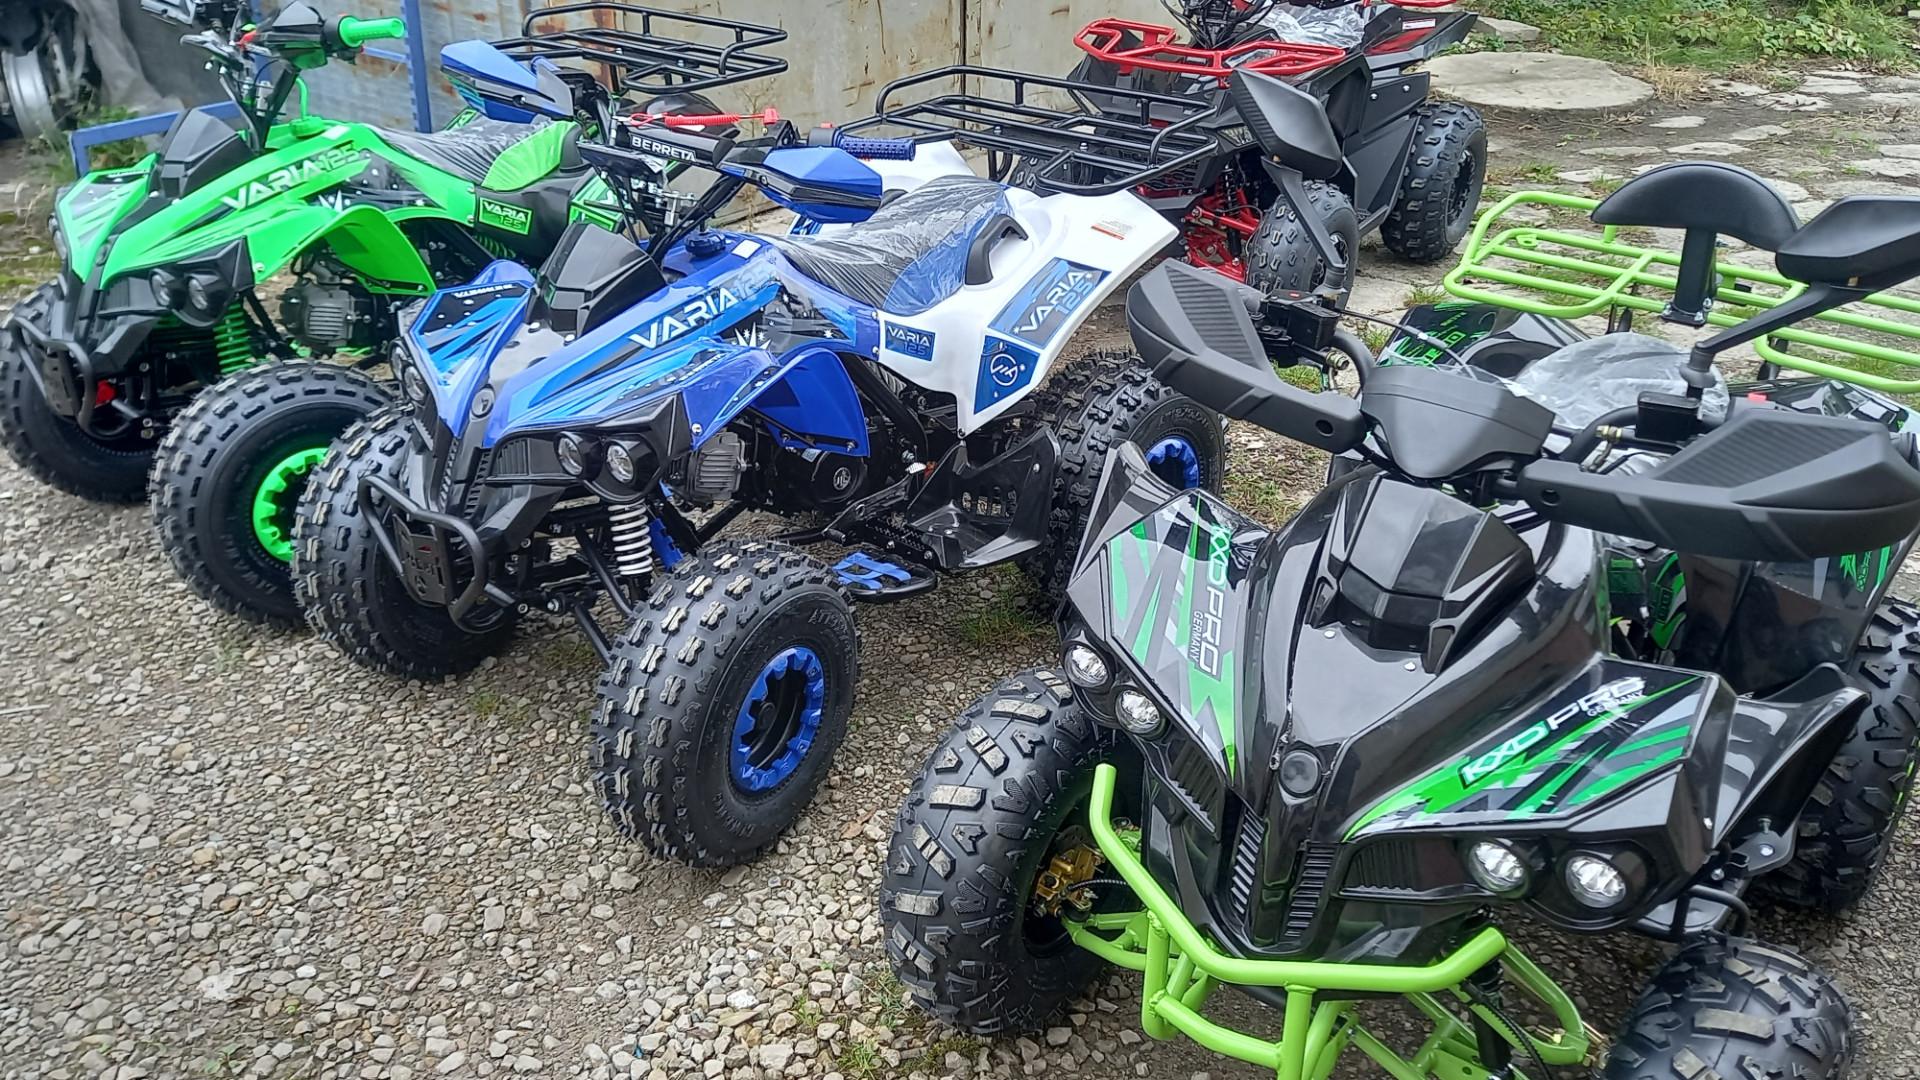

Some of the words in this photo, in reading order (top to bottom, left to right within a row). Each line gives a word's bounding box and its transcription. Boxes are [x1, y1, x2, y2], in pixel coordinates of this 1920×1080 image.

[632, 136, 696, 162] BERRETA
[221, 159, 321, 210] VARIA
[484, 201, 526, 221] VARIA
[499, 215, 522, 228] 125
[1020, 271, 1086, 332] VARIA
[1055, 279, 1094, 315] 125
[628, 287, 740, 349] VARIA
[887, 325, 931, 347] VARIA
[904, 341, 926, 356] 125
[1192, 611, 1204, 663] GERMANY
